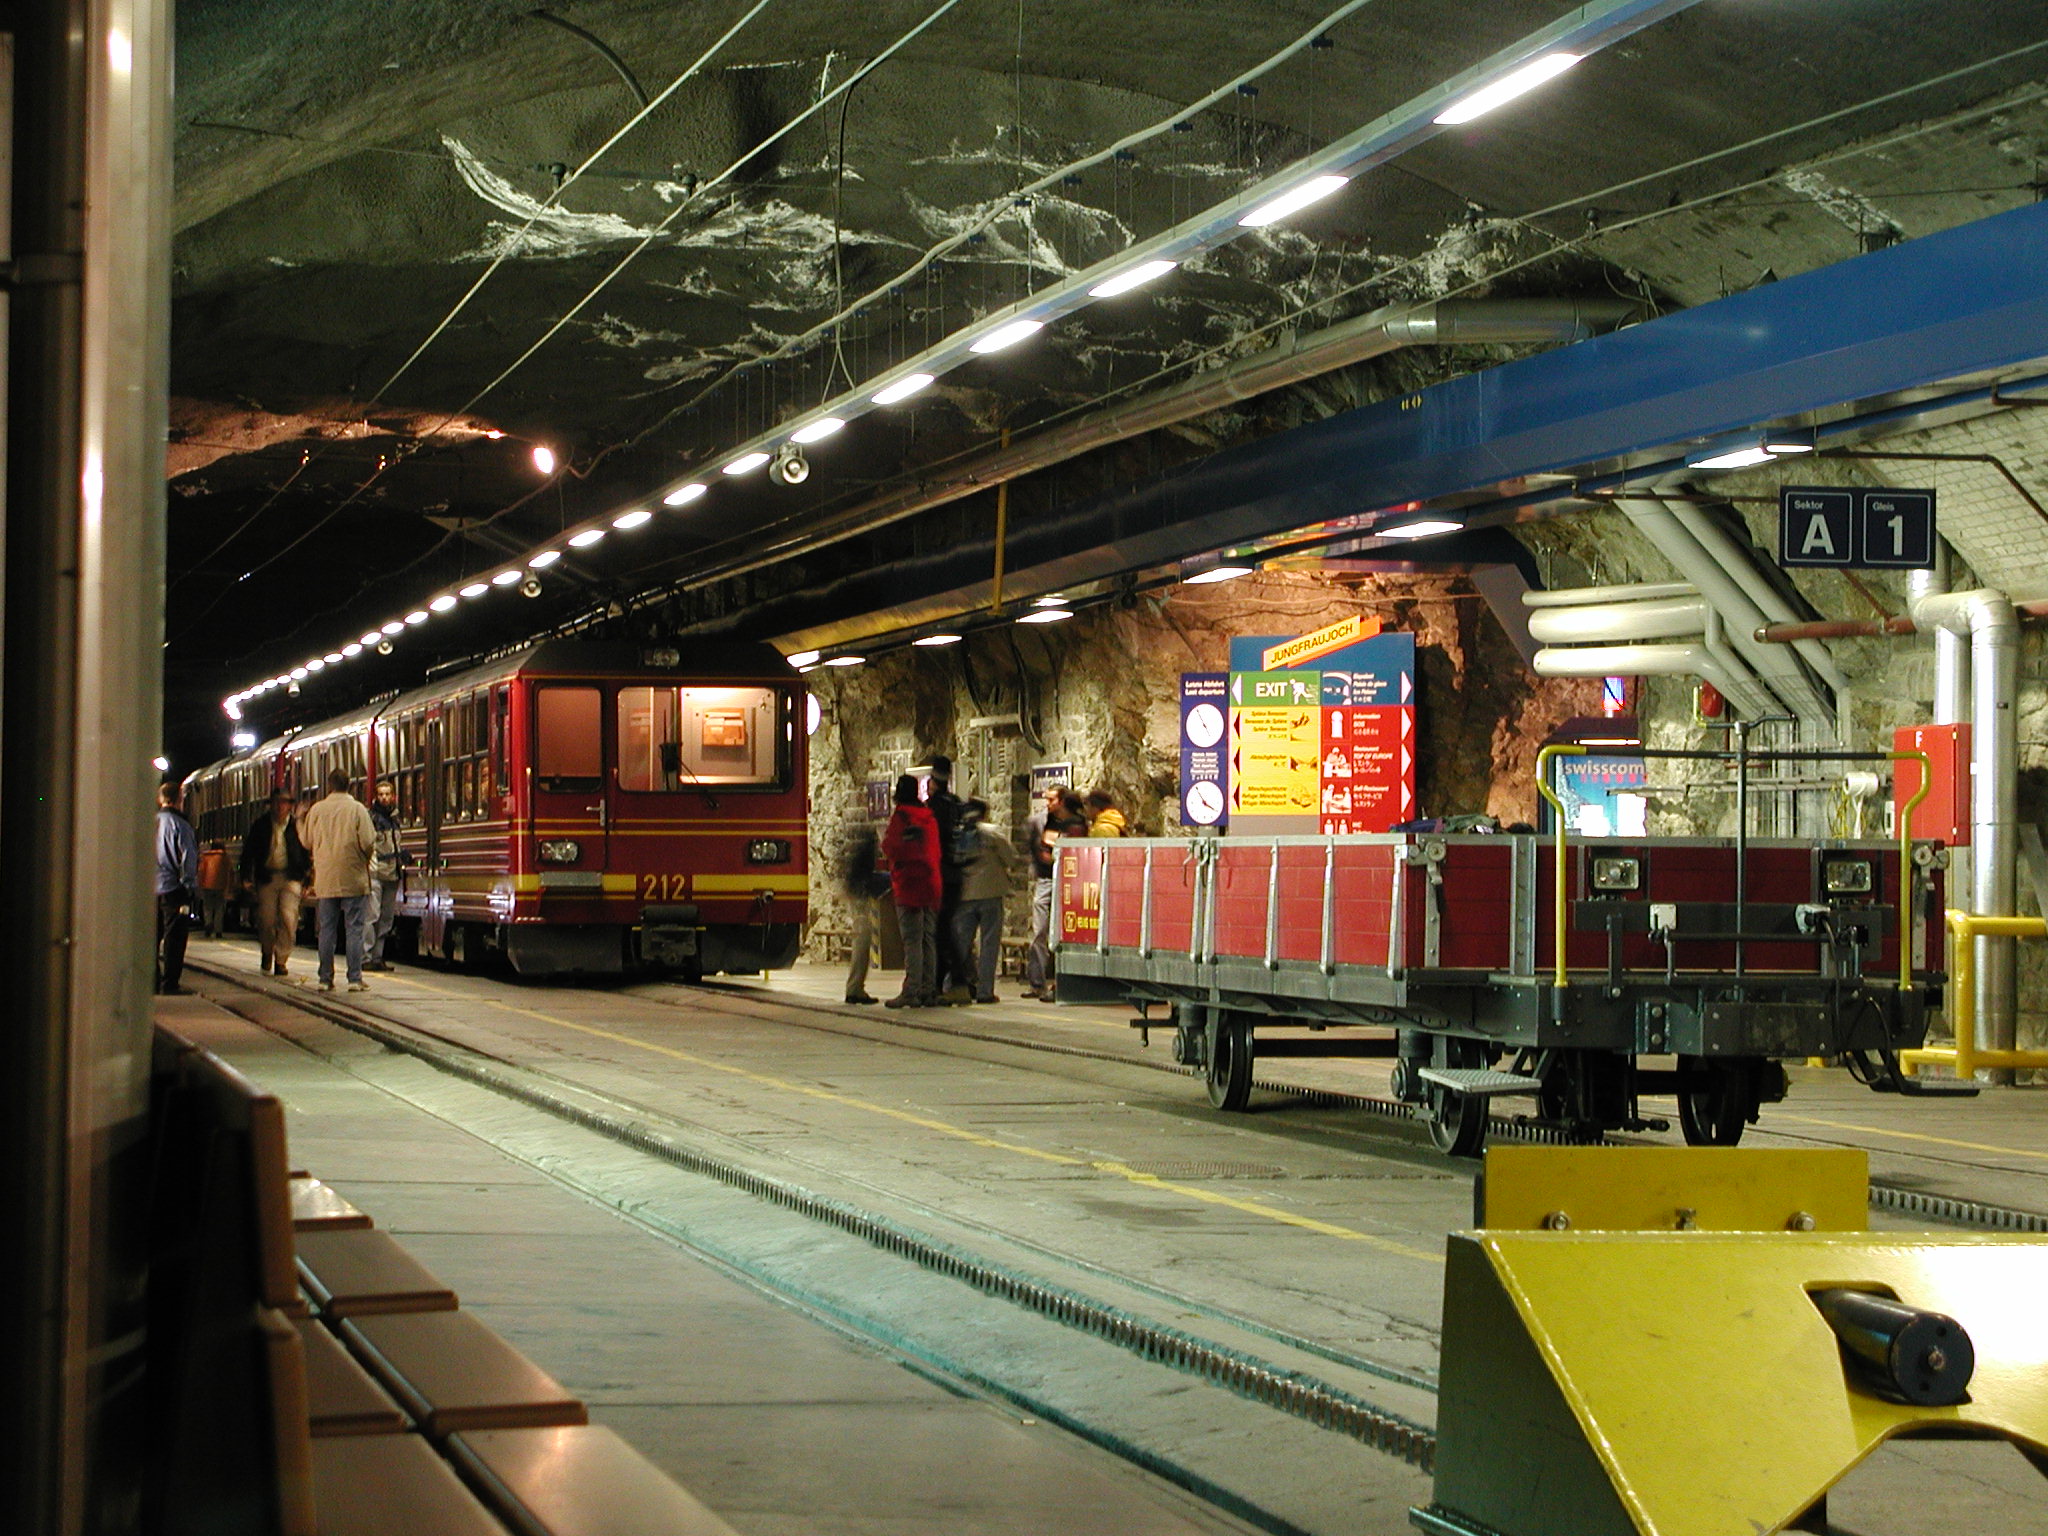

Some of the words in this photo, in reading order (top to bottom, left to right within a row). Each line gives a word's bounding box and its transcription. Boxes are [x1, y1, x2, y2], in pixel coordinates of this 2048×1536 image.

[1793, 500, 1824, 510] Sektor
[1872, 501, 1895, 512] Gleis
[1801, 513, 1835, 555] A
[1887, 515, 1903, 556] 1
[1270, 623, 1354, 664] JUNGFRAUJOCH
[1255, 682, 1289, 698] EXIT
[1915, 730, 1923, 748] F
[1564, 759, 1645, 775] swisscom
[643, 873, 685, 900] 212
